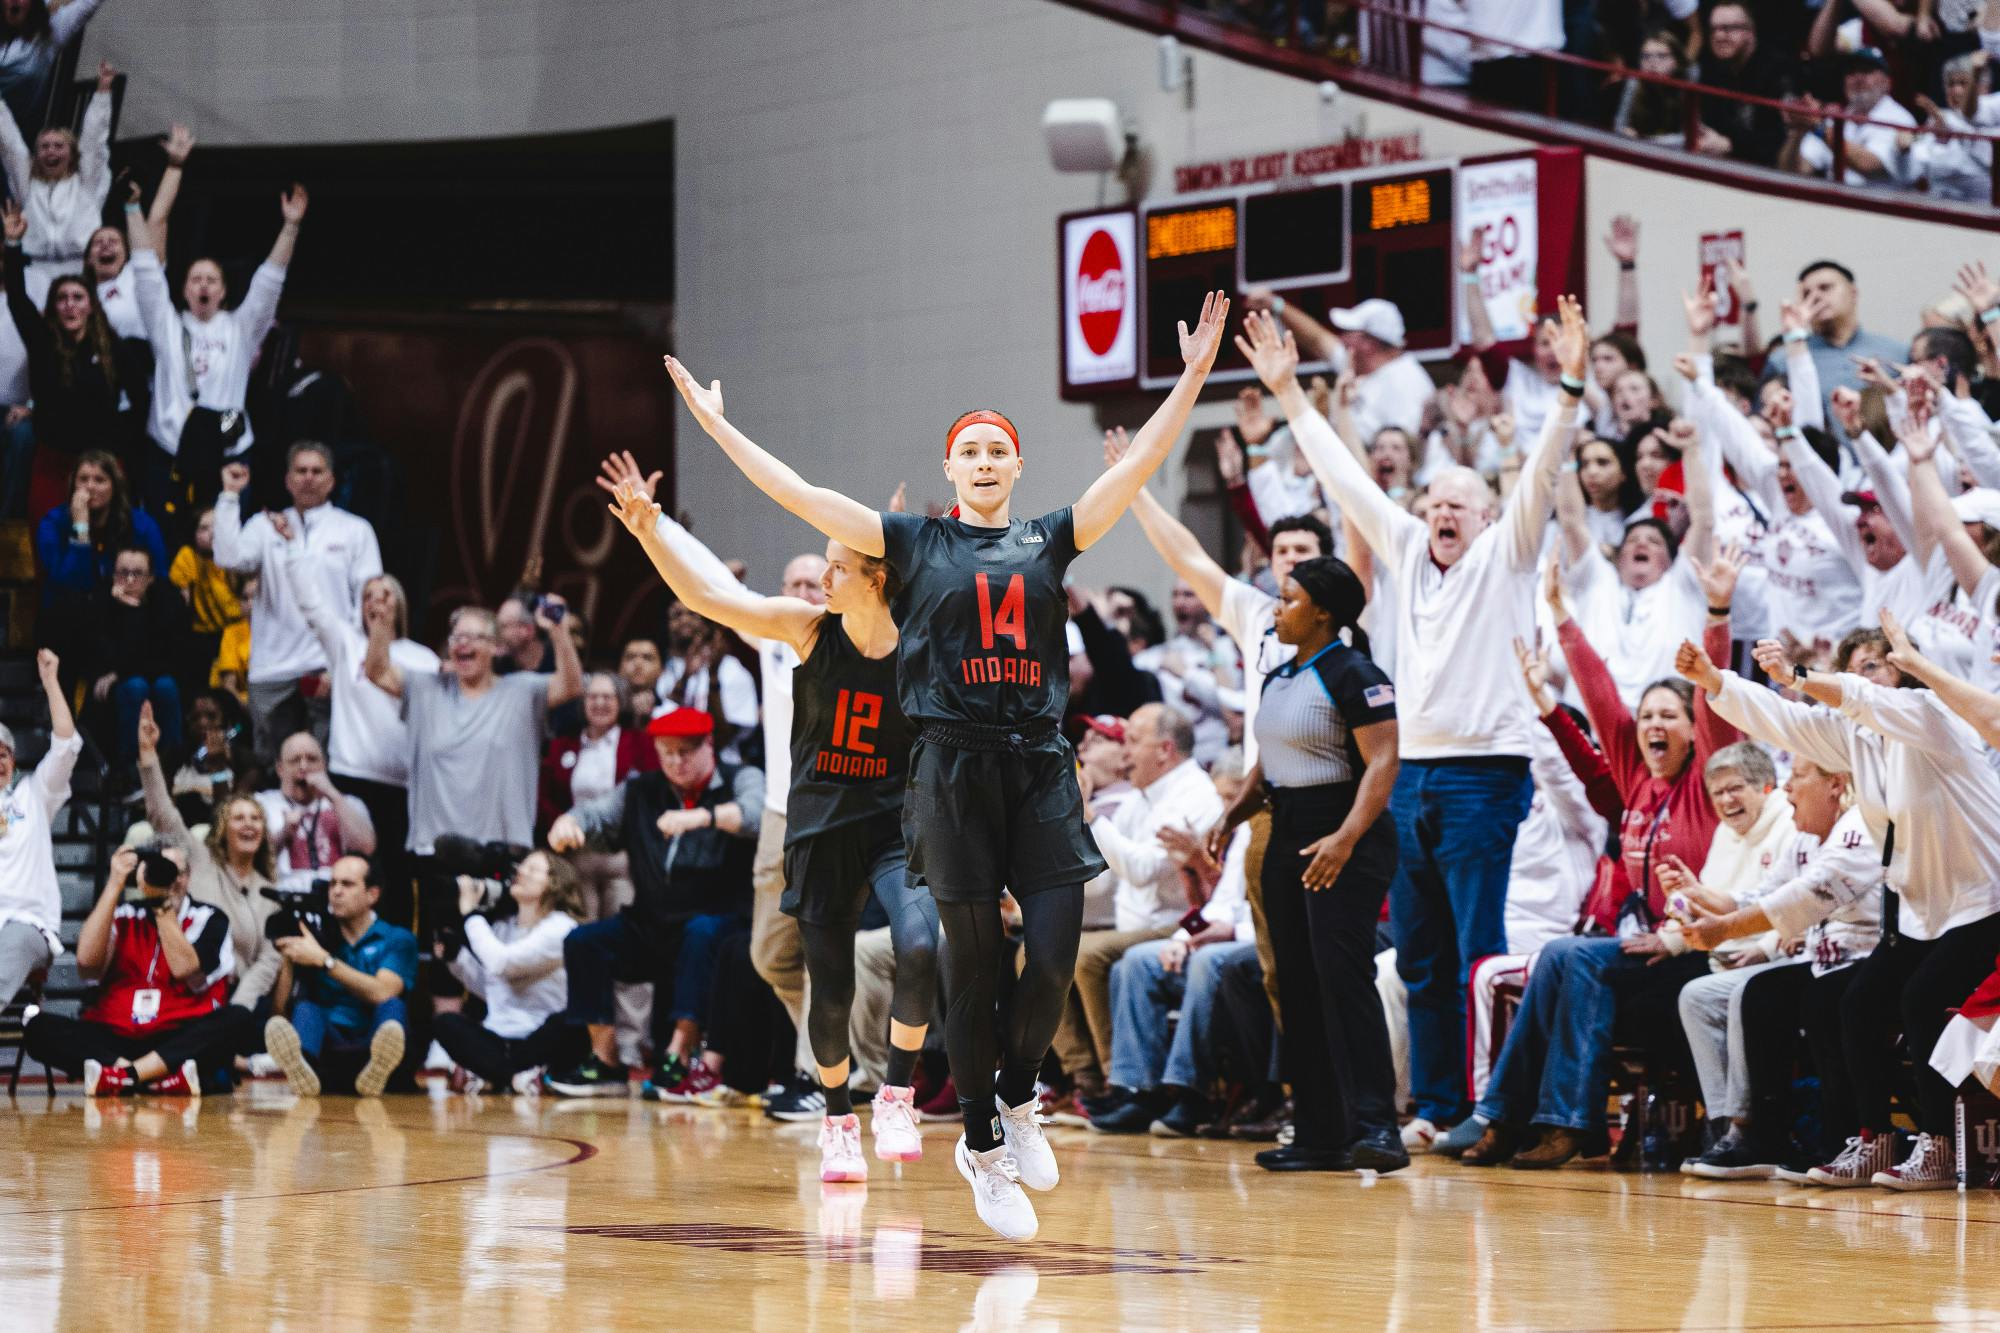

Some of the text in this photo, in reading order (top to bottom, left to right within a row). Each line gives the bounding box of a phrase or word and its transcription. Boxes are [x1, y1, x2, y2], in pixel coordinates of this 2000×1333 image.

[1478, 215, 1519, 264] GO
[976, 572, 1027, 650] 14
[961, 656, 1041, 687] INDANA
[832, 688, 883, 754] 12
[816, 751, 887, 777] NDIANA
